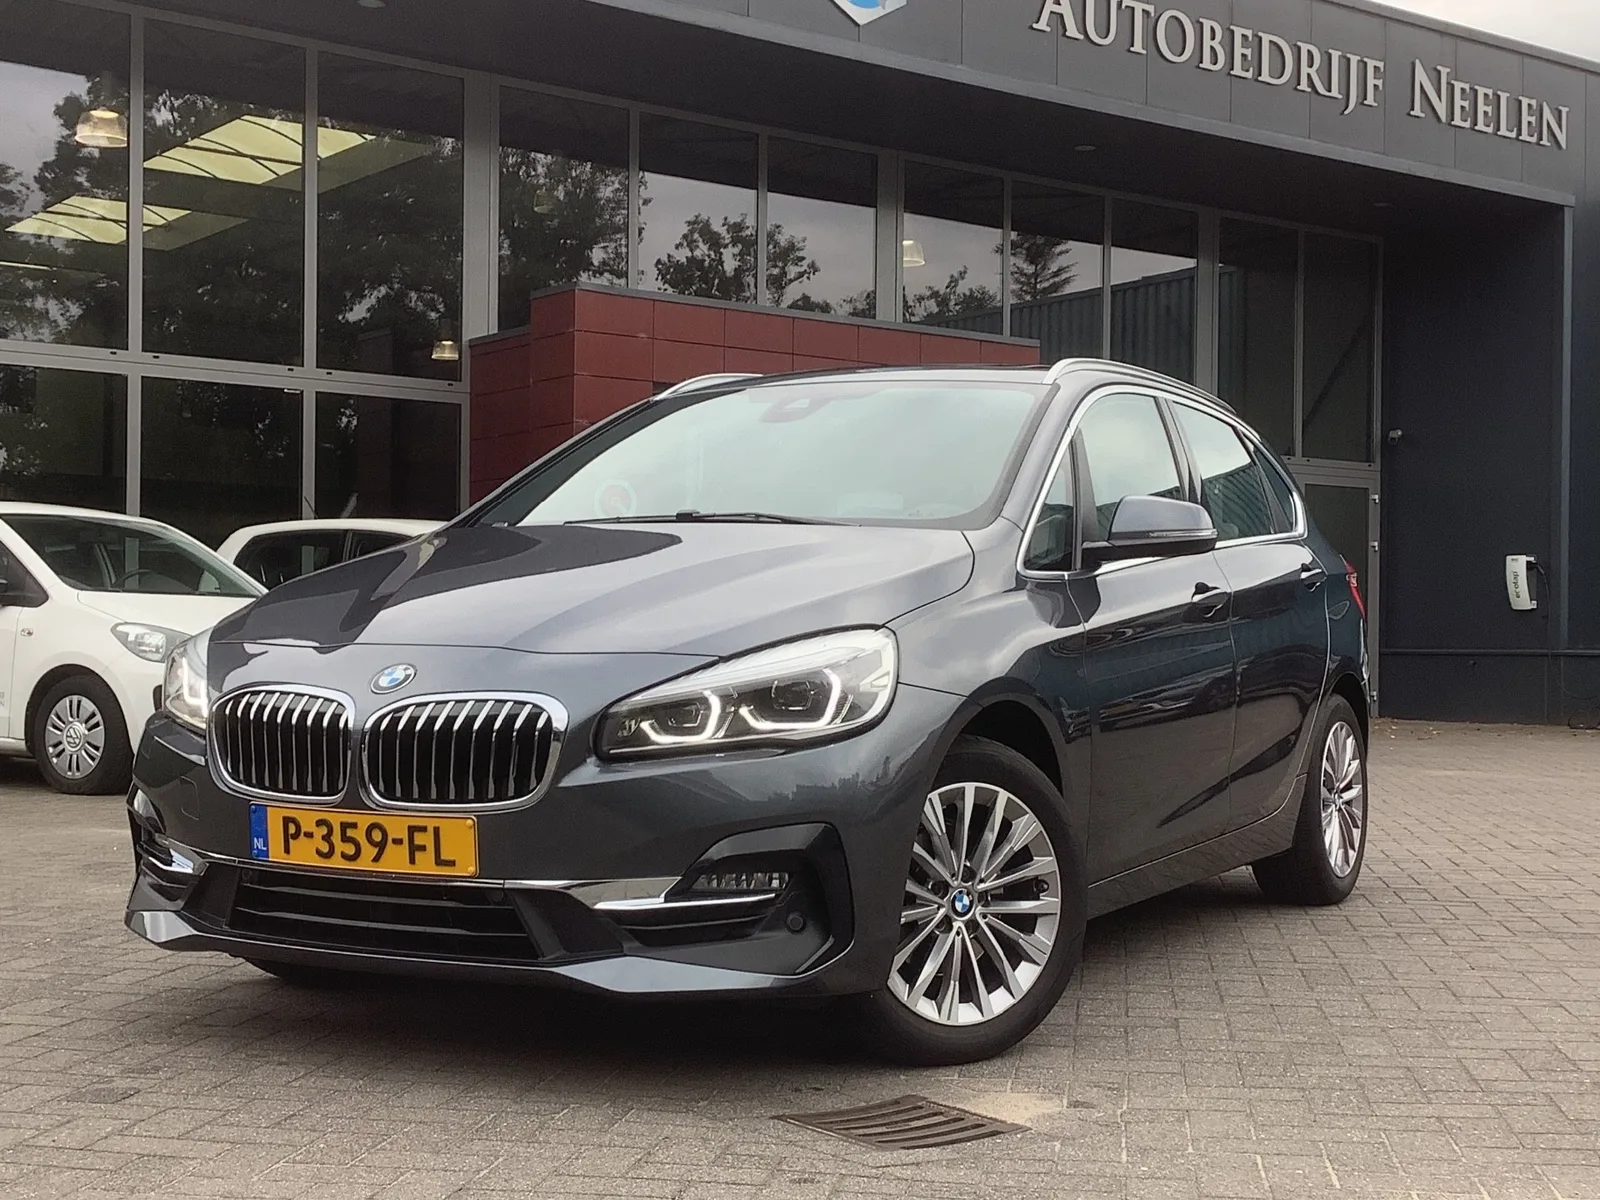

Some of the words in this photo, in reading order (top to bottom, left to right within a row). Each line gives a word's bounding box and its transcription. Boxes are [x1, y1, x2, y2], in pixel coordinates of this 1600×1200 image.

[1031, 0, 1385, 115] AUTOBEDRIJF
[1410, 58, 1570, 150] NEELEN
[253, 837, 267, 851] NL
[282, 815, 456, 867] P-359-FL
